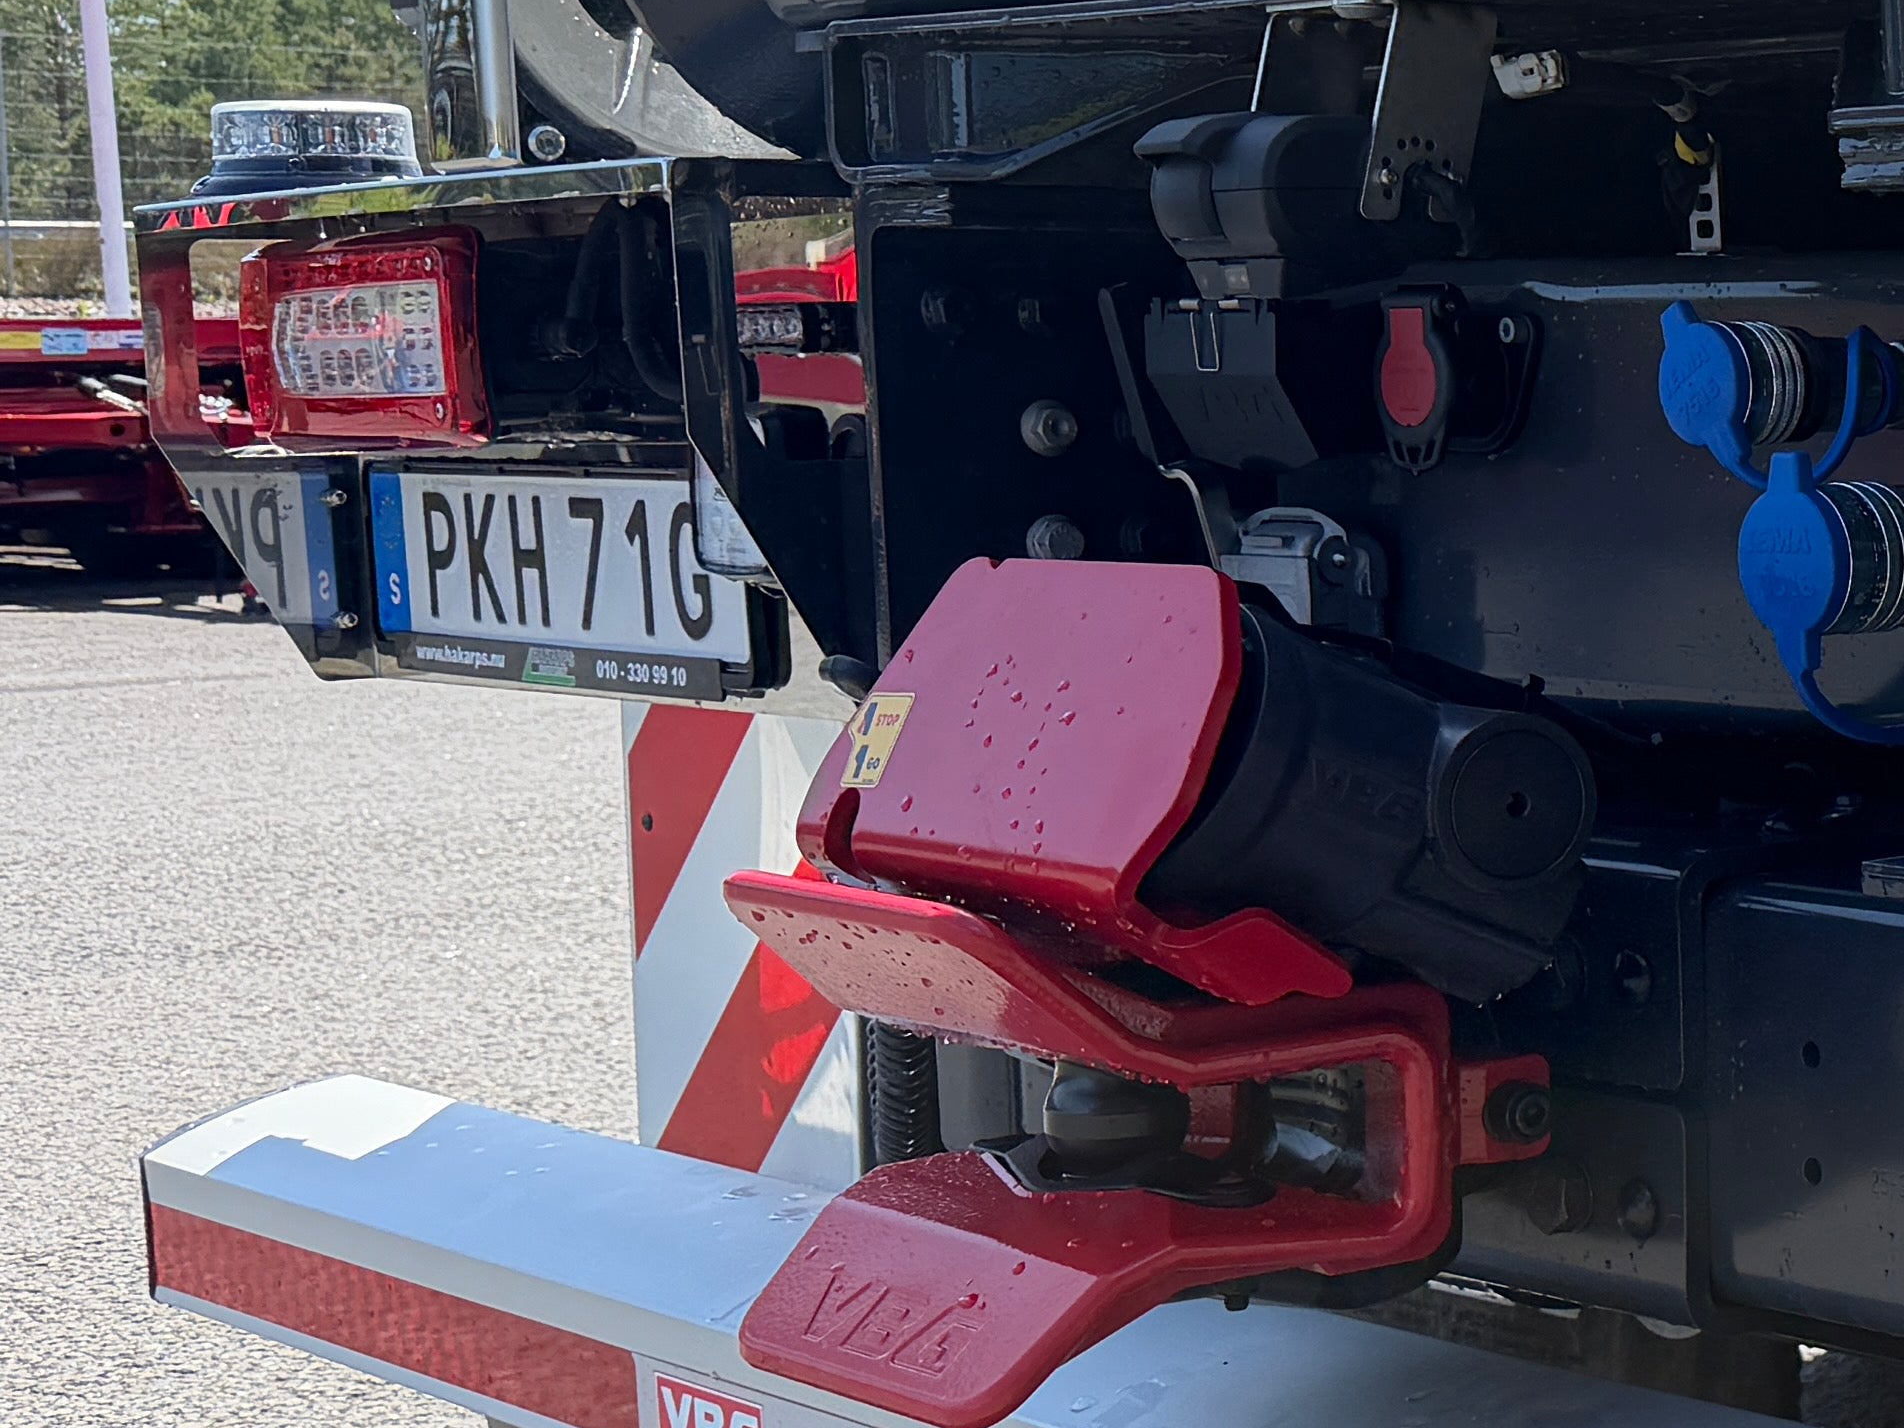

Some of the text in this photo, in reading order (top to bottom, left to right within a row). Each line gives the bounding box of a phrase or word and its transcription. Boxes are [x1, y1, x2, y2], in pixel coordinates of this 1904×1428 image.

[422, 491, 551, 628] PKH
[389, 573, 401, 605] S
[415, 644, 506, 669] www.hakarps.nu
[595, 659, 618, 680] 010
[627, 663, 650, 683] 330
[653, 666, 669, 685] 99
[671, 667, 688, 687] 10
[875, 713, 900, 727] STOP
[866, 757, 881, 770] GO
[801, 1271, 986, 1378] VBG
